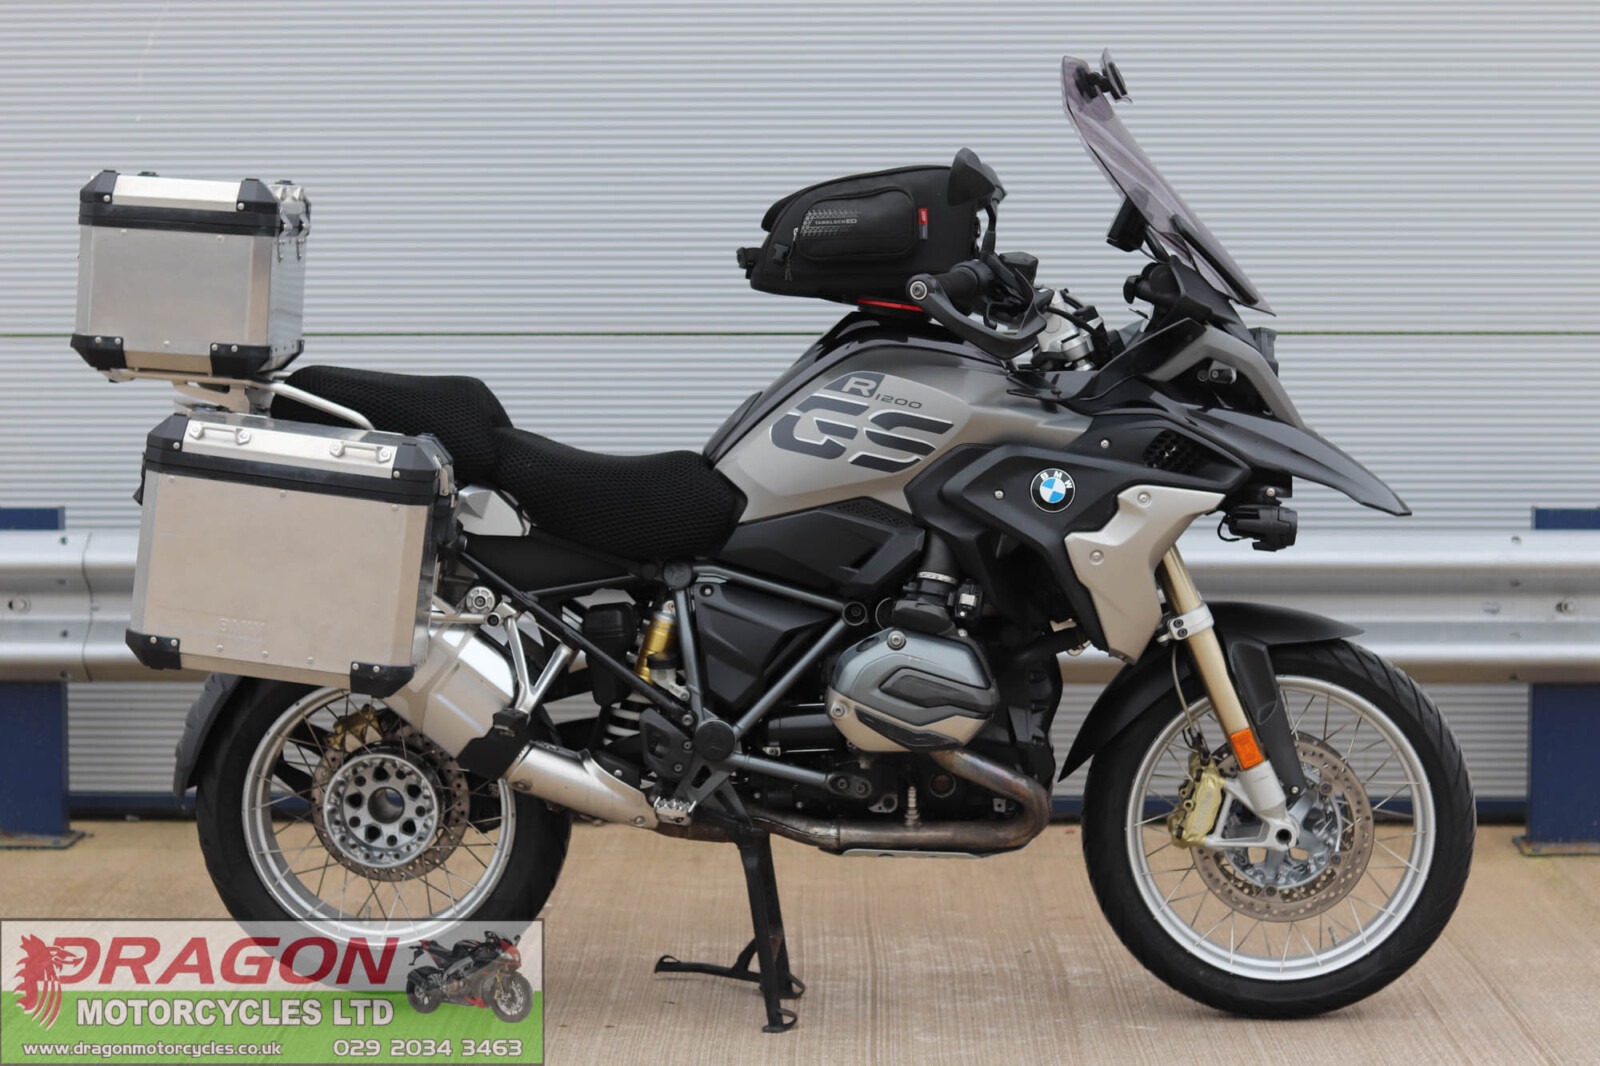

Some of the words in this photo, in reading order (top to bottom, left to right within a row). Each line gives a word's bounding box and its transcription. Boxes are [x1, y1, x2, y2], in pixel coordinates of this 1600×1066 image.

[841, 376, 878, 398] R
[875, 393, 923, 410] 1200
[768, 393, 955, 474] GS
[1040, 470, 1072, 489] BMW
